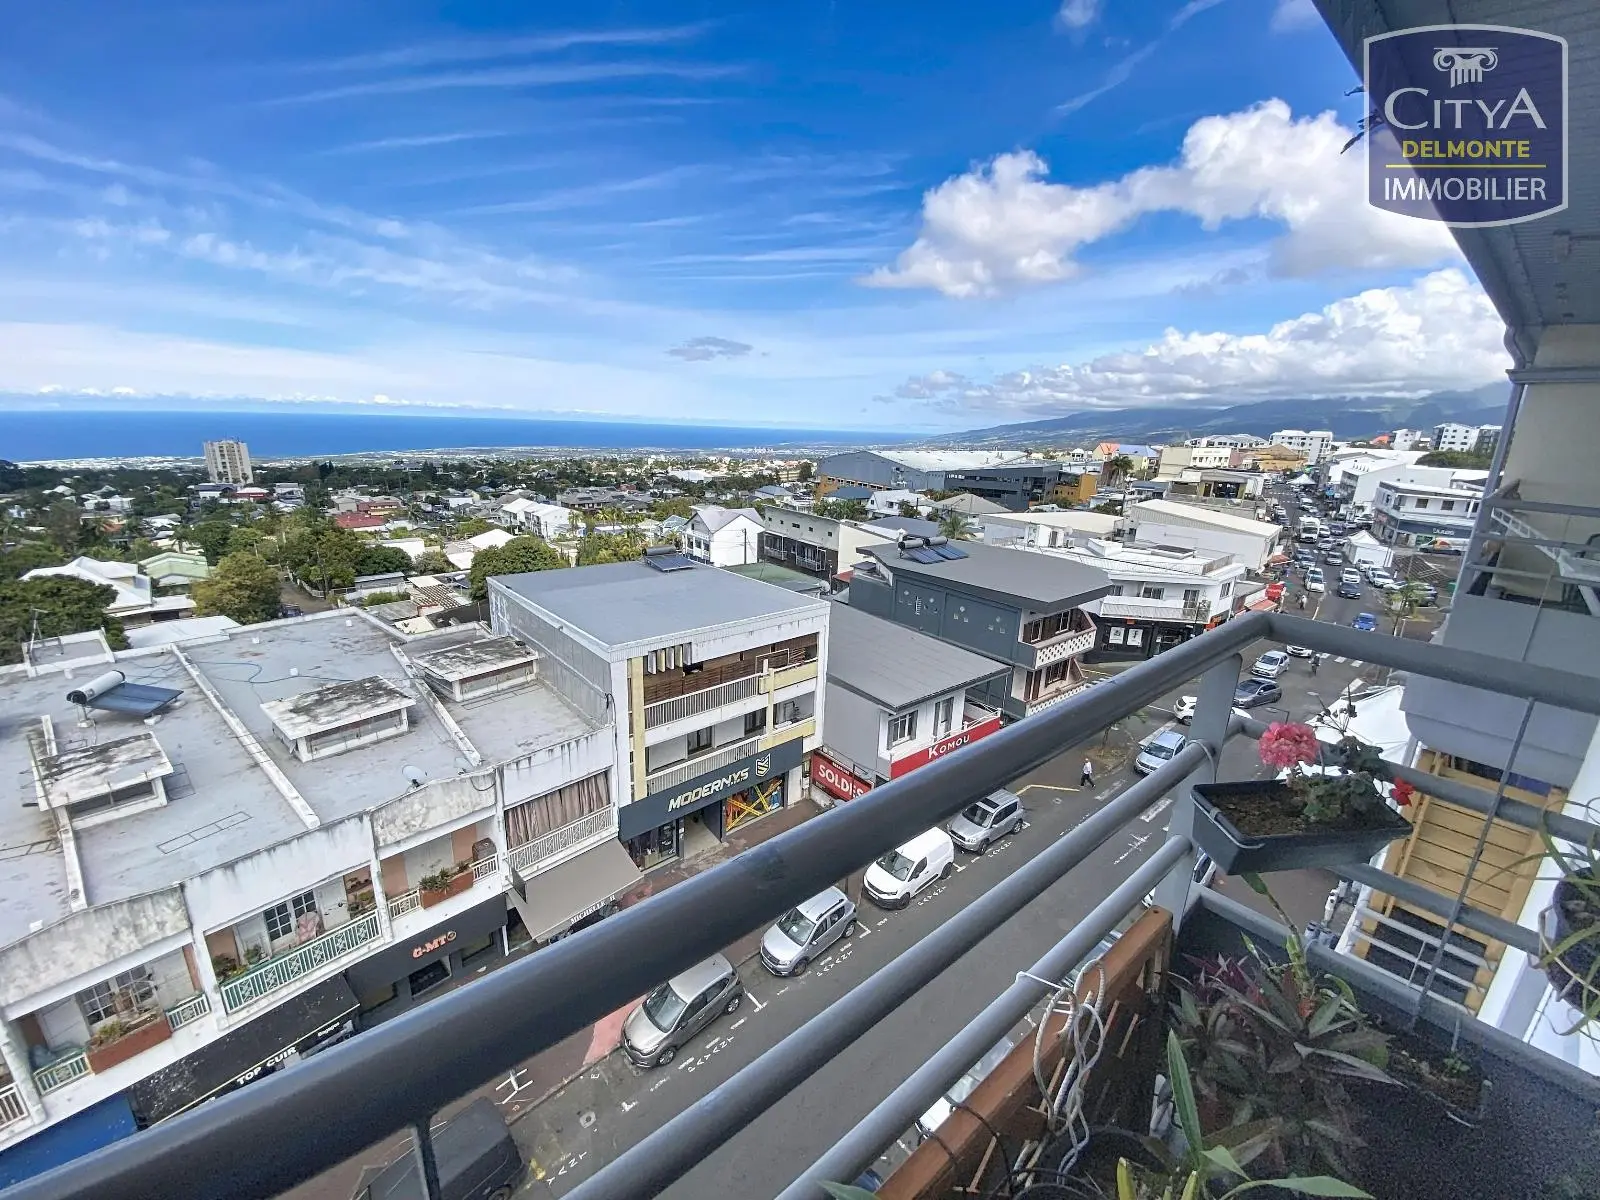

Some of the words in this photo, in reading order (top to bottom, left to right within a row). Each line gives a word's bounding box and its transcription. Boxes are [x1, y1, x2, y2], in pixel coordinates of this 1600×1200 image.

[928, 734, 970, 760] KOMOU
[816, 950, 853, 977] PAYANT
[236, 1066, 262, 1085] TOP
[266, 1046, 297, 1067] CUIR
[687, 1035, 735, 1073] PAYANT
